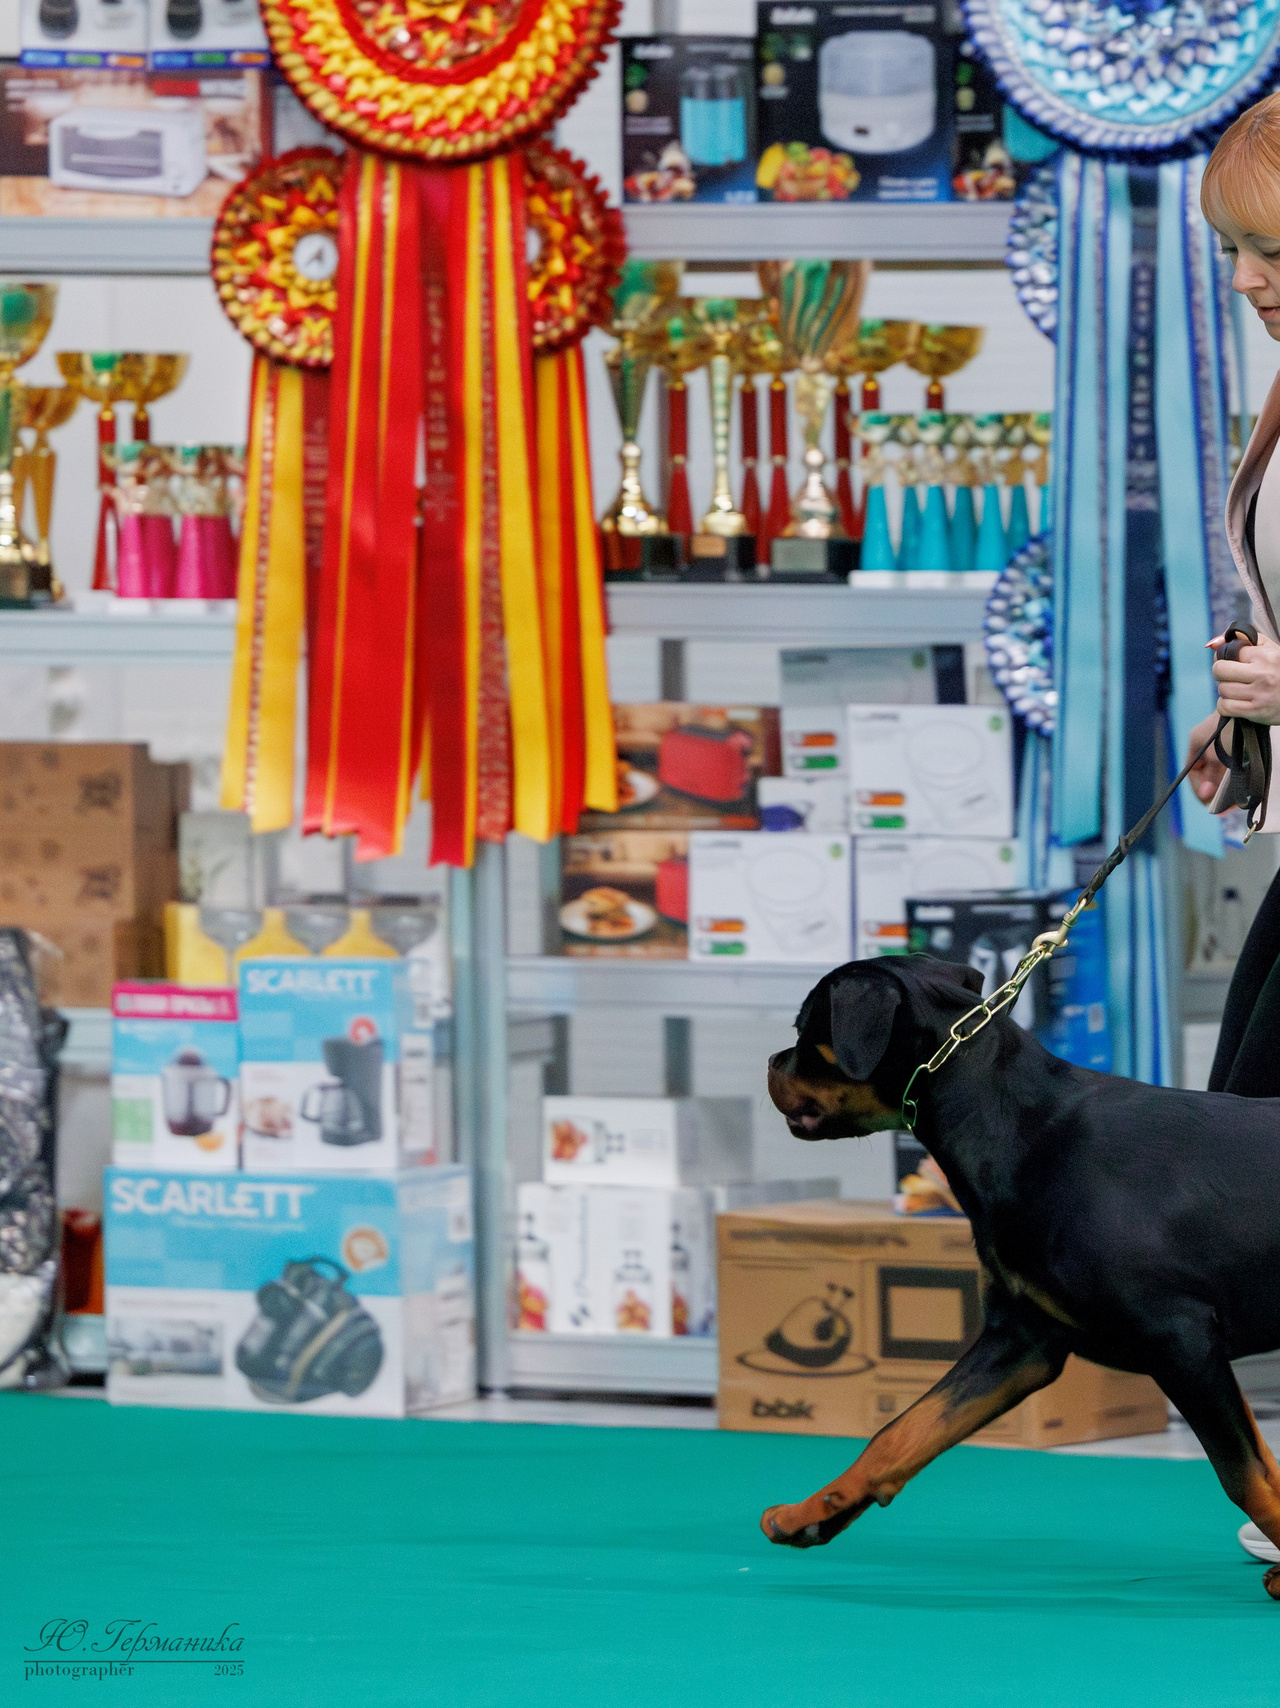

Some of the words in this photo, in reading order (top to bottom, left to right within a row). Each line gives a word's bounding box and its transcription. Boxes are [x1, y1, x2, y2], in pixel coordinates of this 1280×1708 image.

[247, 968, 378, 996] SCARLETT
[112, 1177, 317, 1218] SCARLETT
[752, 1396, 816, 1420] bbk
